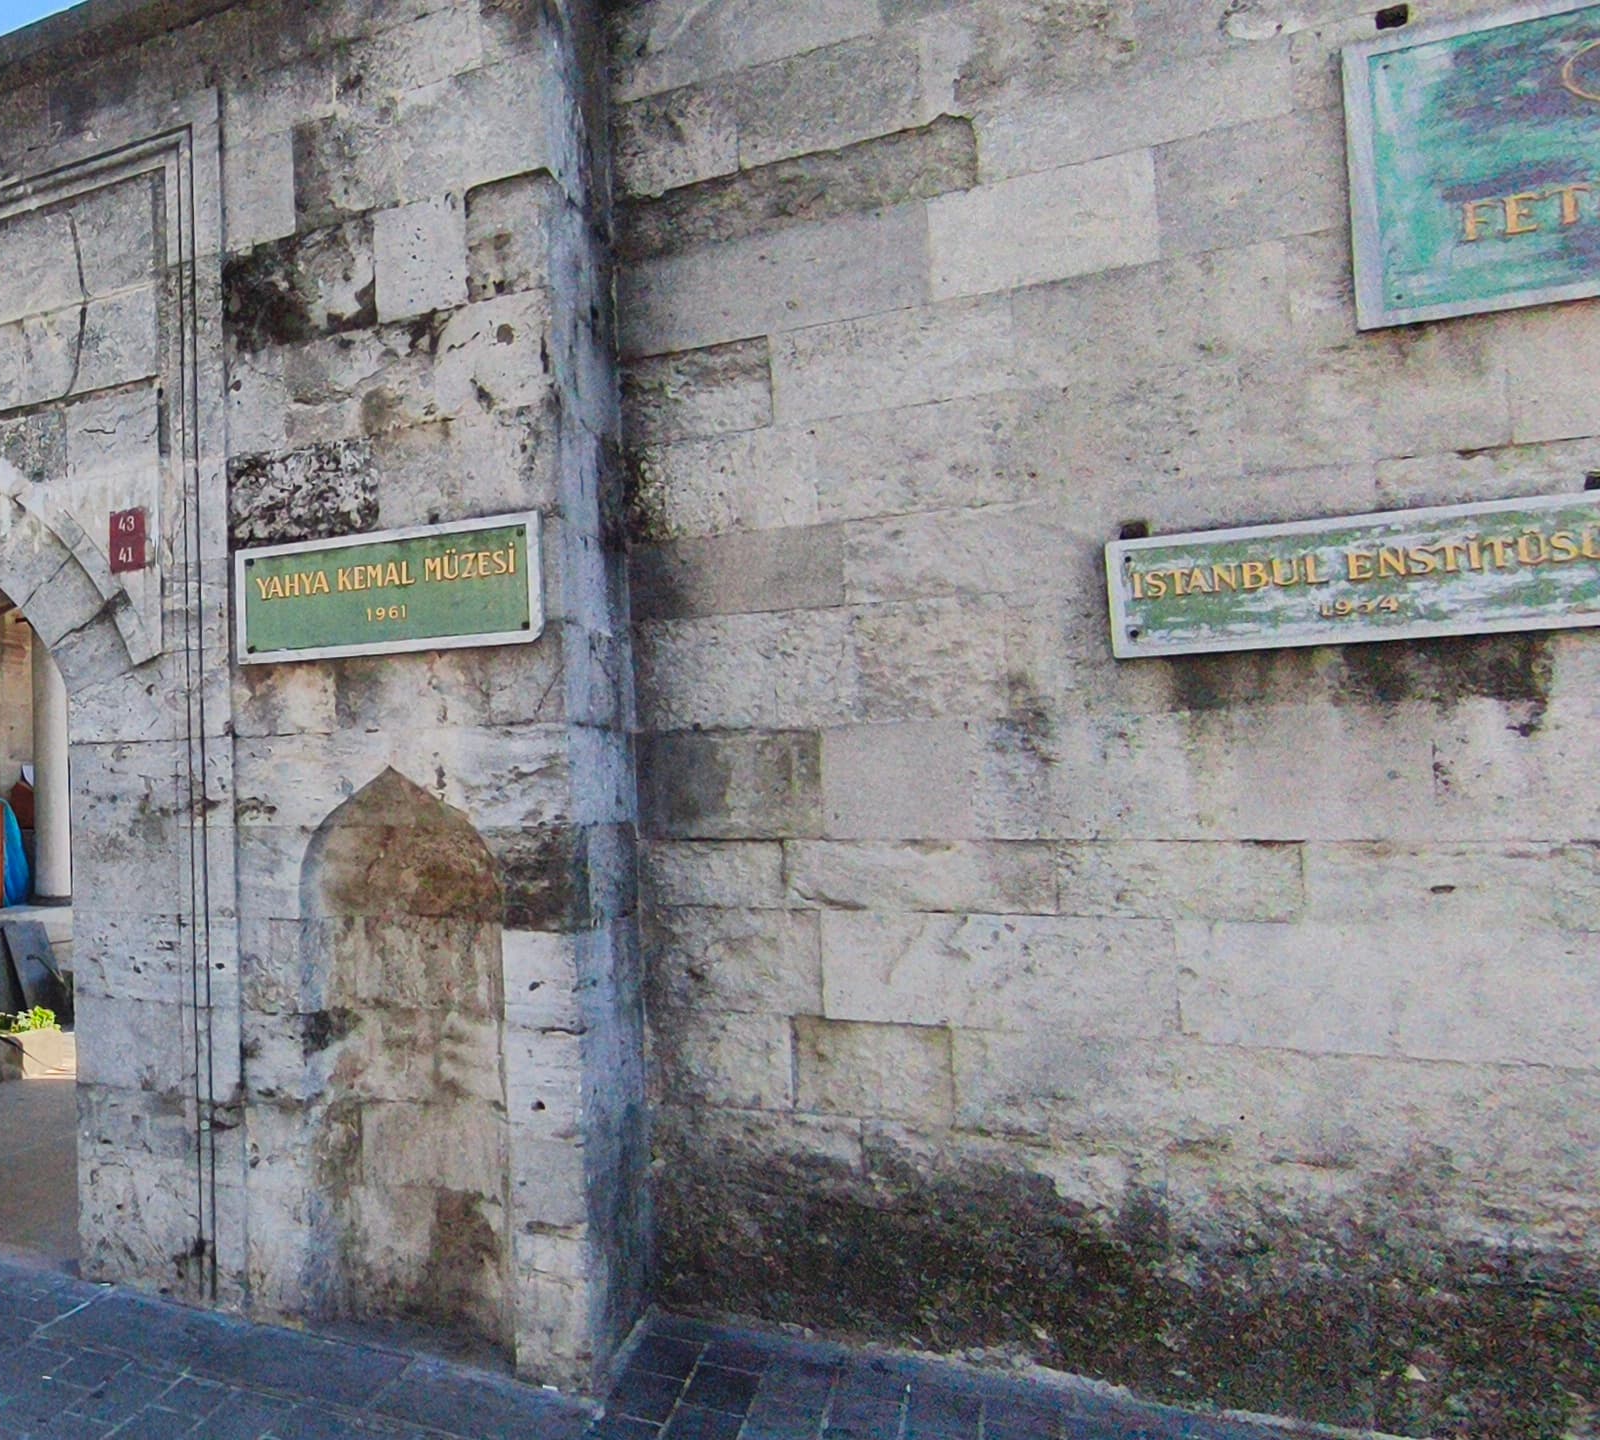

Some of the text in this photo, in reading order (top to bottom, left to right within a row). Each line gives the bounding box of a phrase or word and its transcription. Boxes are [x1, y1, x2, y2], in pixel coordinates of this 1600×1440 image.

[118, 546, 133, 563] 41
[256, 541, 517, 600] YAHYA KEMAL MÜZESİ
[366, 604, 408, 622] 1961
